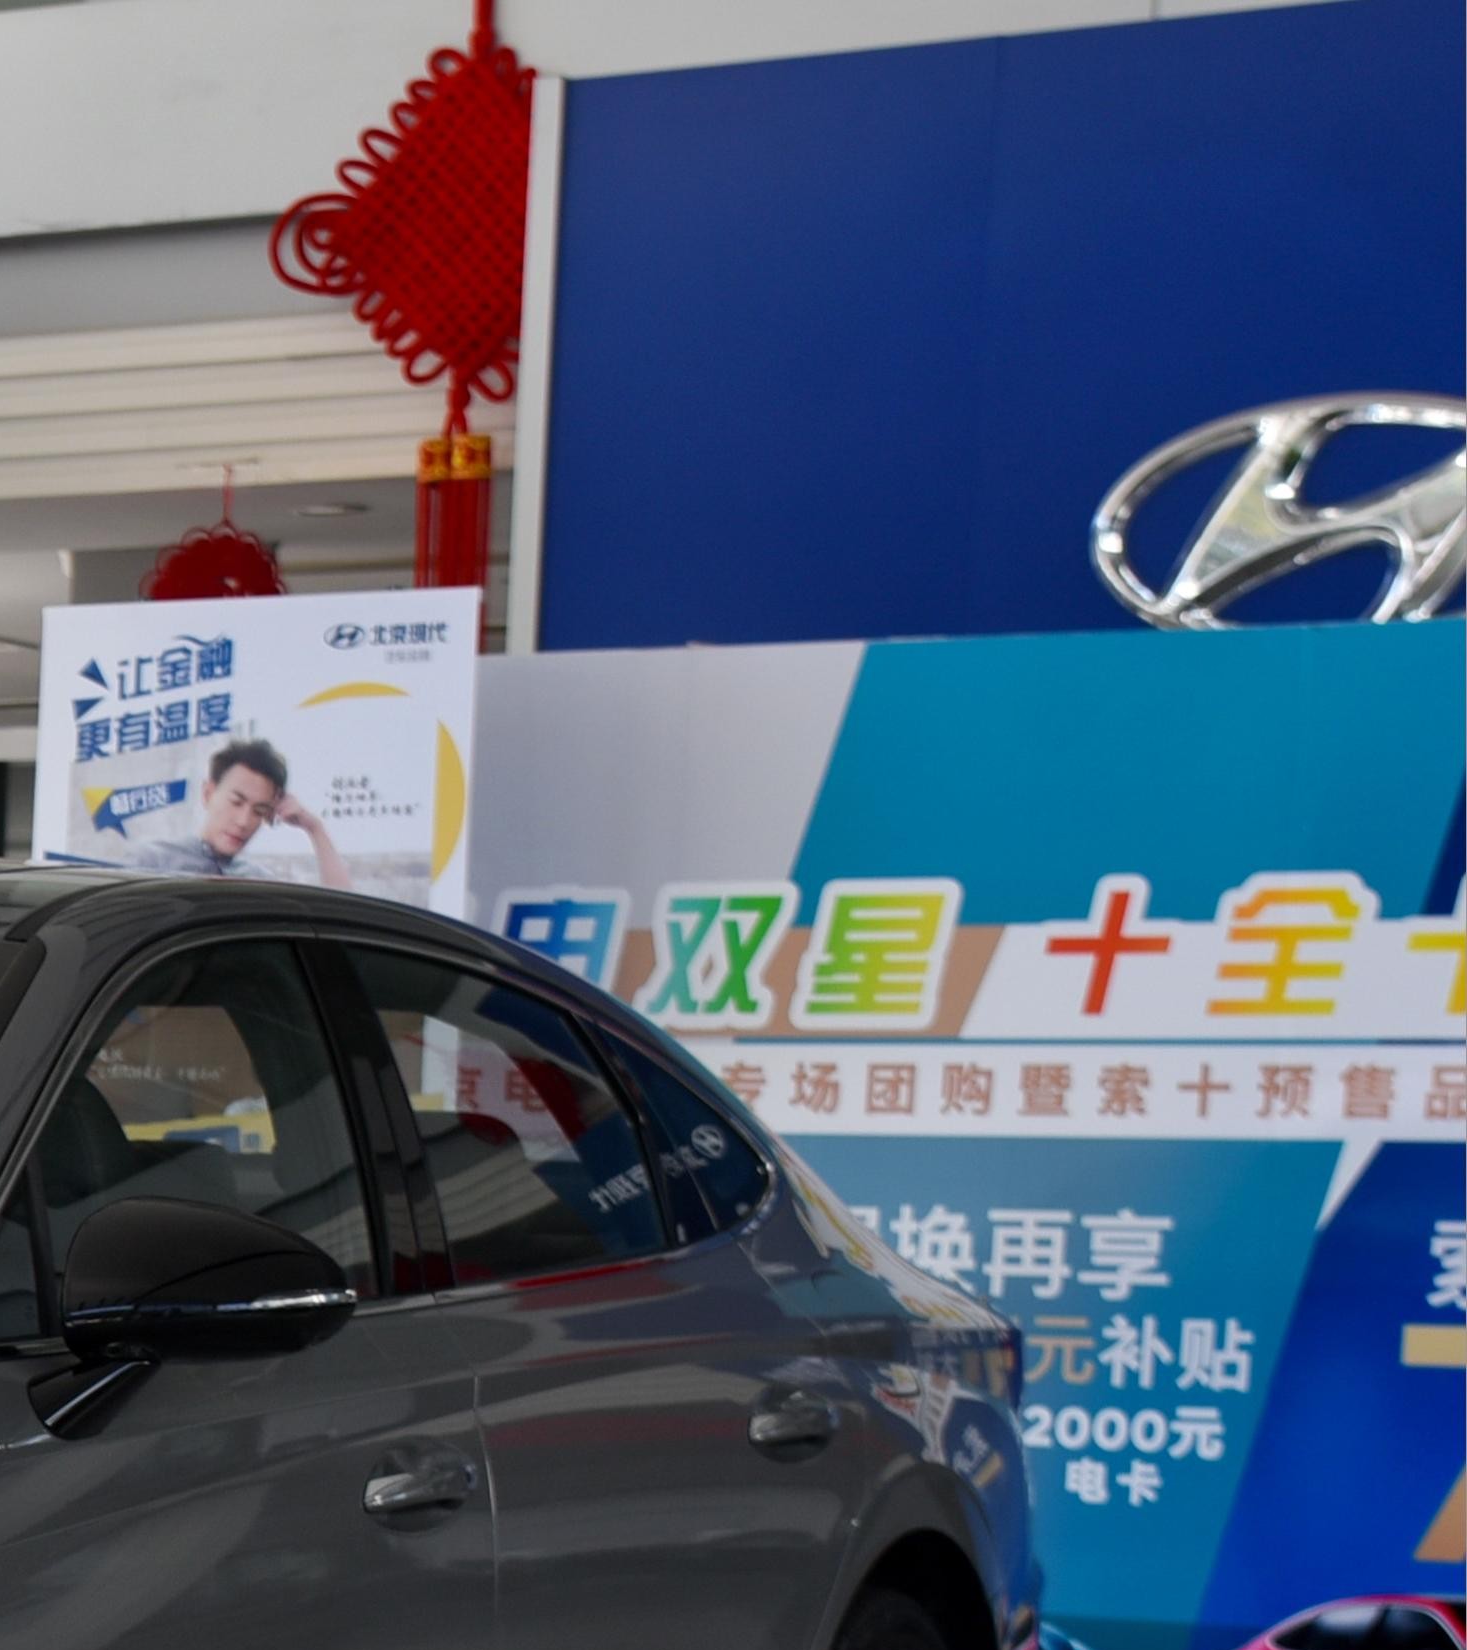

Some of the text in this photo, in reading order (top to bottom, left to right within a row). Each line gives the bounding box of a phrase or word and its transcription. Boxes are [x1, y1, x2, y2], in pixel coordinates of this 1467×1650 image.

[370, 622, 449, 646] 北京现代
[117, 636, 233, 701] 让金融
[76, 692, 232, 762] 更有温度
[847, 1205, 1174, 1302] 换再享
[1011, 1315, 1255, 1393] 元补贴
[1022, 1405, 1226, 1461] 2000元
[1064, 1457, 1164, 1507] 电卡
